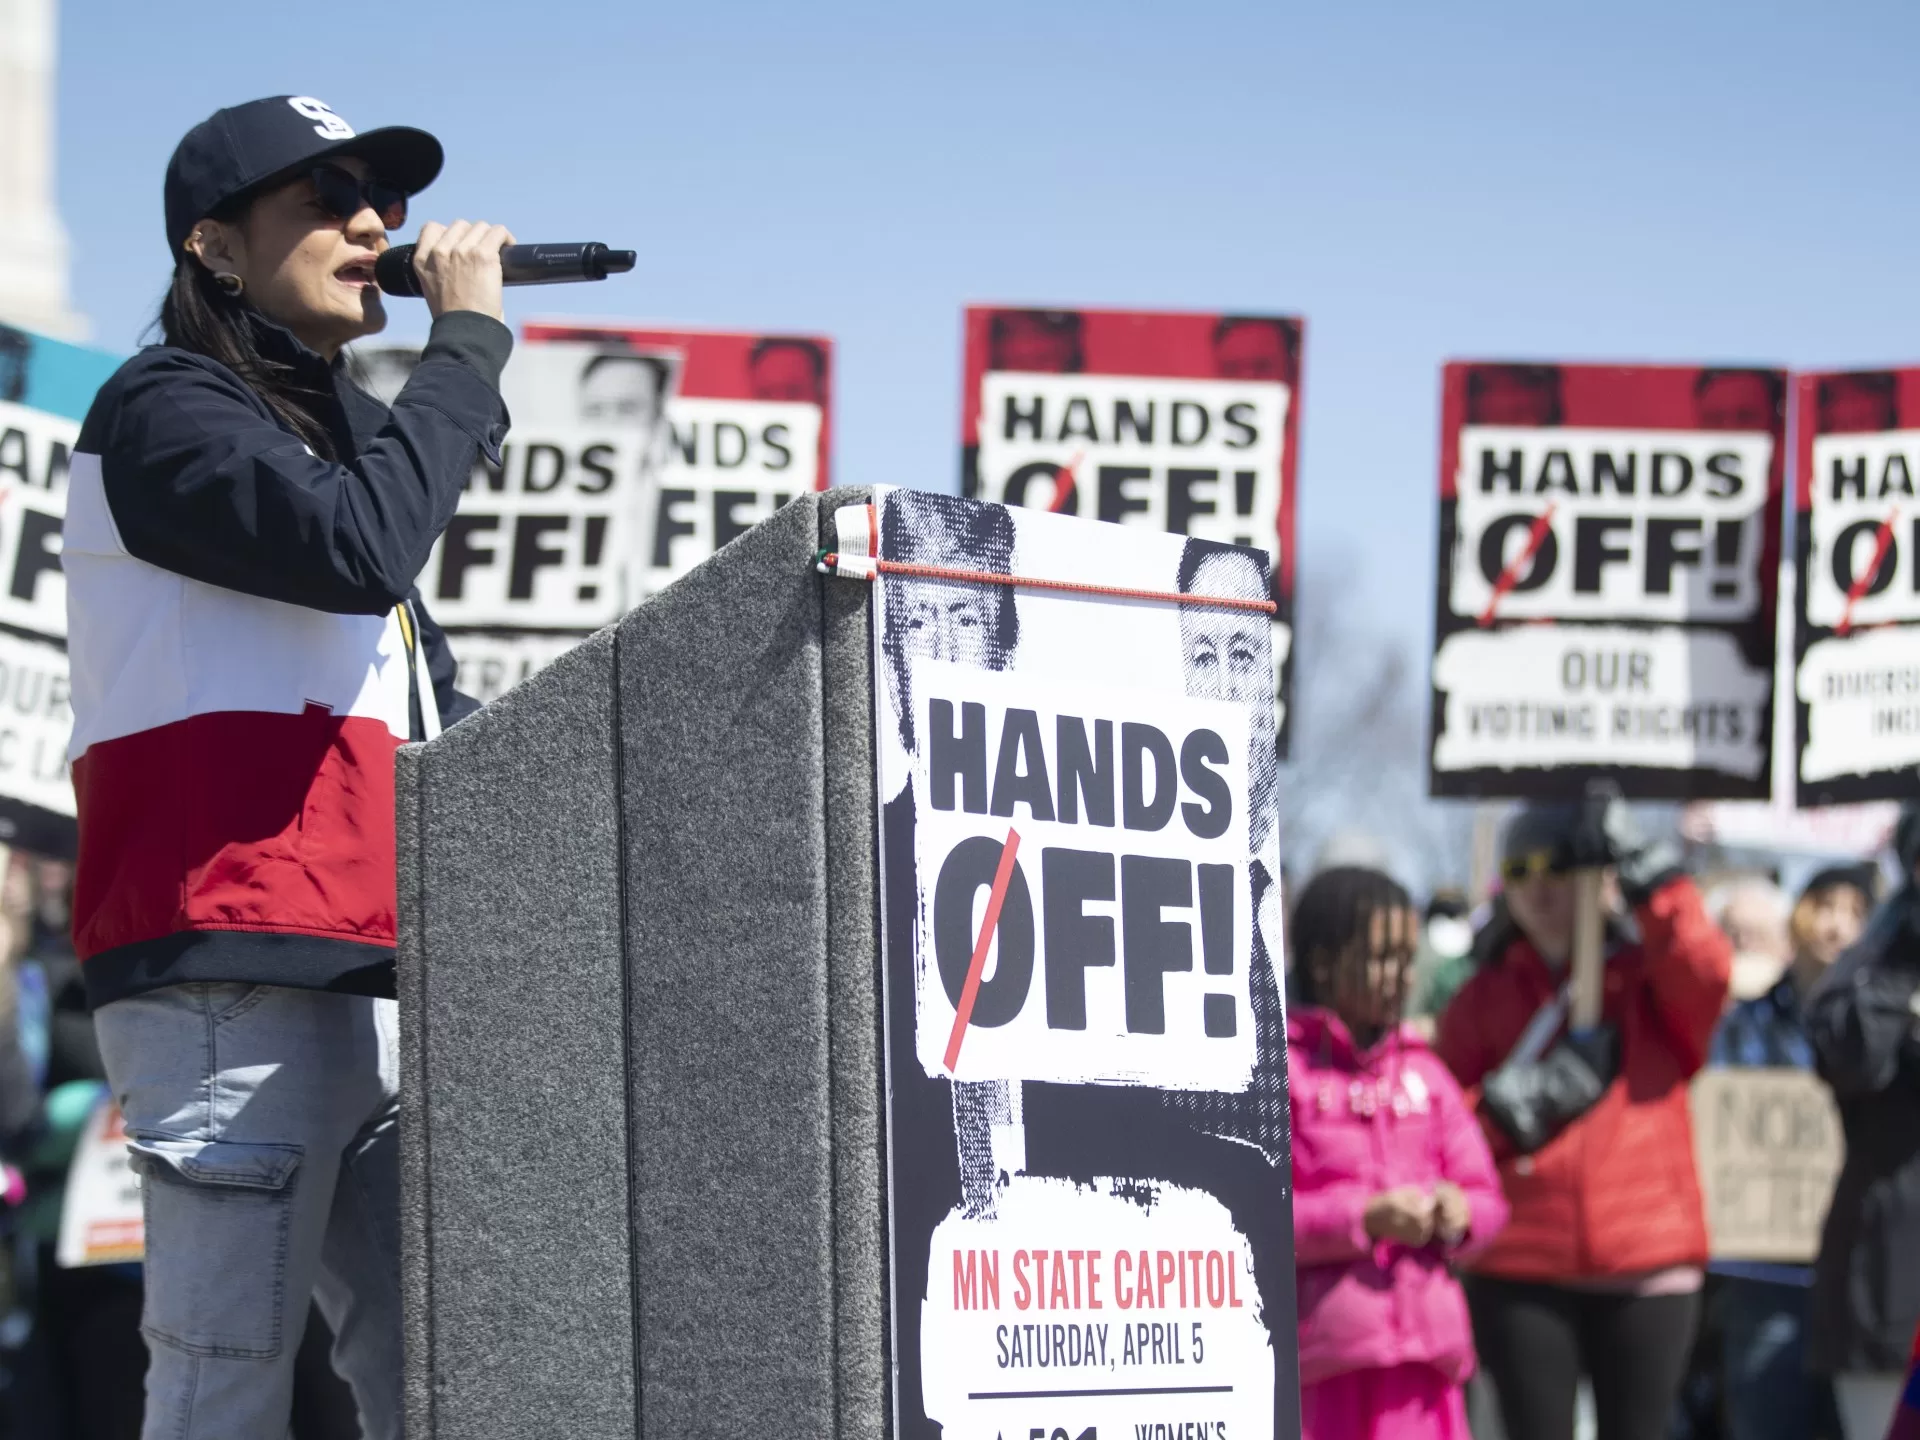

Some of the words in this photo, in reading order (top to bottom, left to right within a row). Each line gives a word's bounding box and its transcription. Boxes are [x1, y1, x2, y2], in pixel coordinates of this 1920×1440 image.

[1004, 394, 1259, 449] HANDS
[1004, 461, 1256, 546] OFF!
[1479, 448, 1744, 499] HANDS
[437, 514, 609, 600] FF!
[1477, 513, 1744, 599] OFF!
[1832, 517, 1920, 598] O
[1562, 650, 1652, 692] OUR
[1467, 702, 1594, 741] VOTING
[1610, 702, 1746, 744] RIGHTS
[929, 698, 1232, 839] HANDS
[933, 836, 1237, 1038] OFF!
[953, 1250, 999, 1310] MN
[1013, 1250, 1101, 1310] STATE
[1114, 1250, 1243, 1309] CAPITOL
[996, 1324, 1115, 1371] SATURDAY,
[1123, 1323, 1185, 1366] APRIL
[1192, 1323, 1204, 1364] 5
